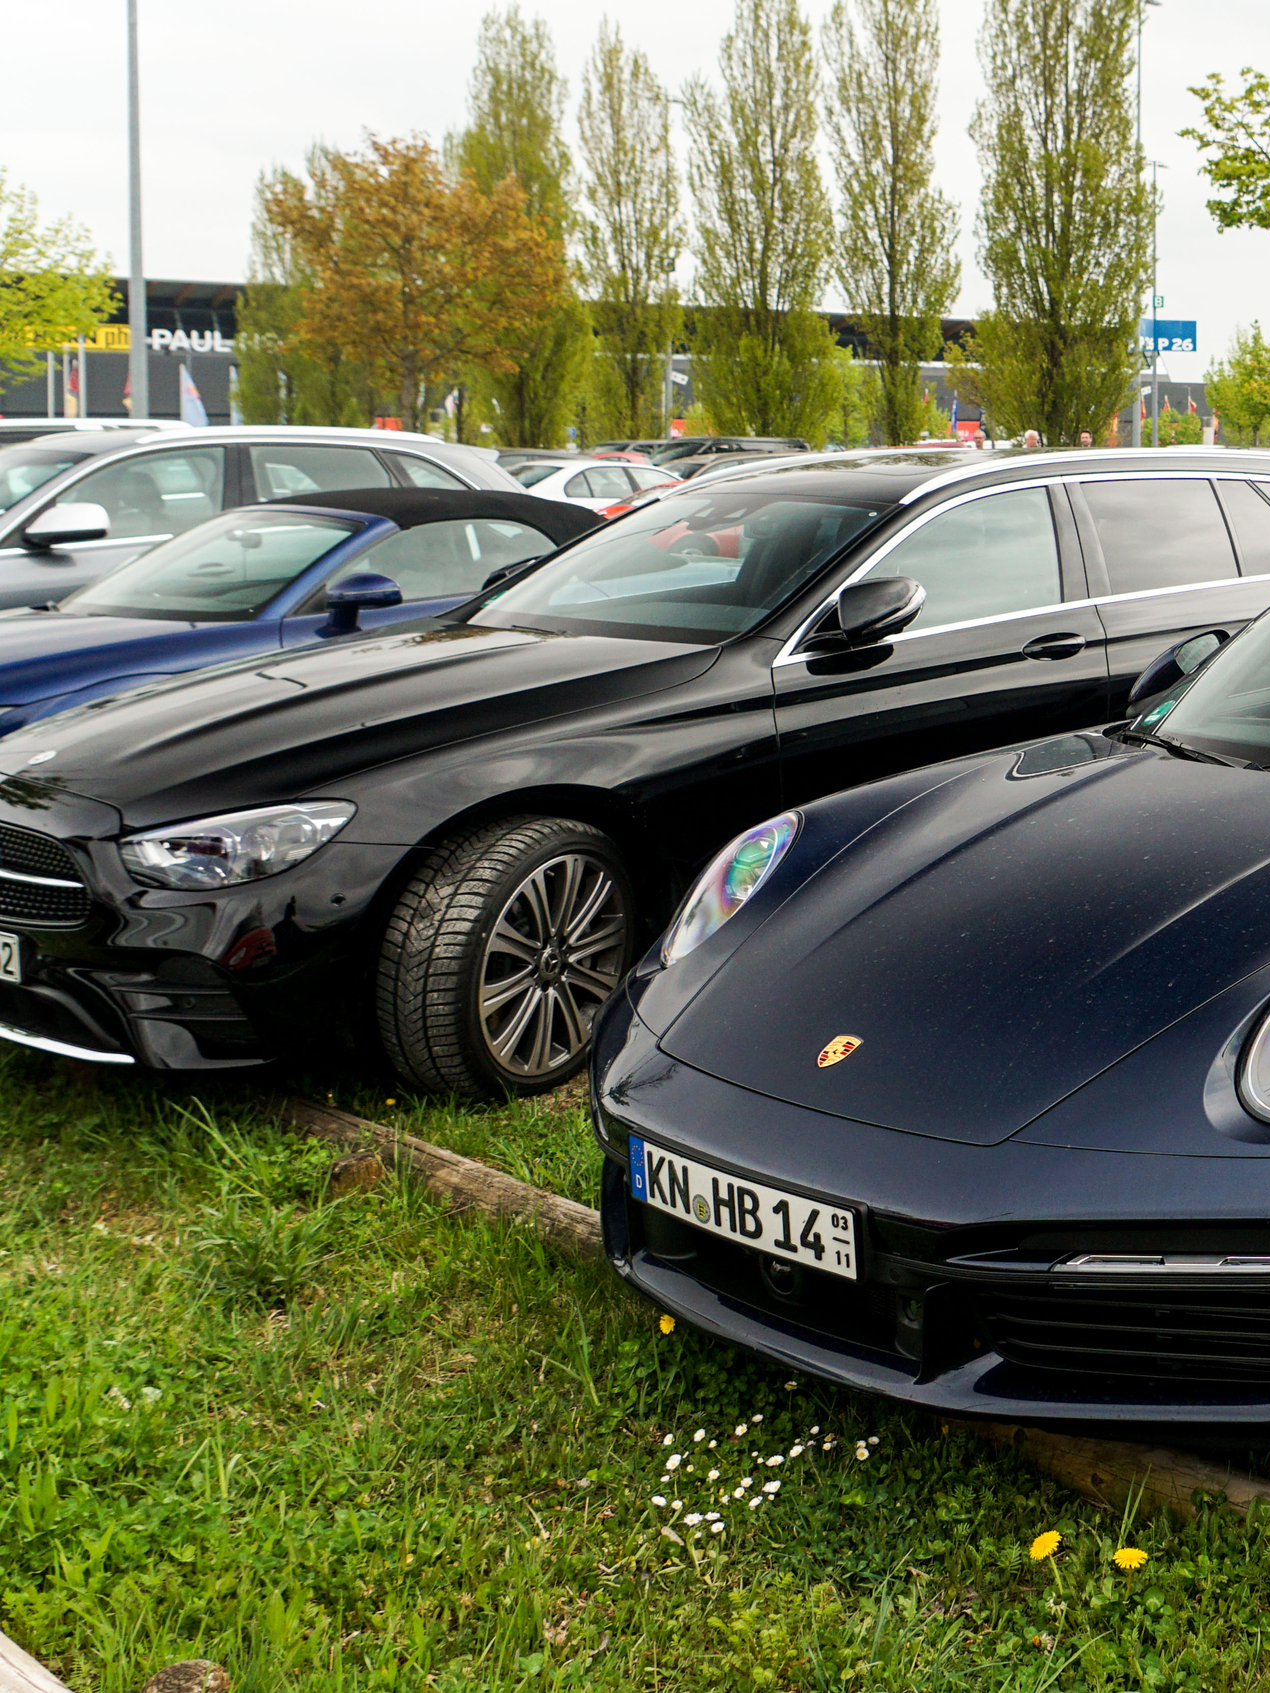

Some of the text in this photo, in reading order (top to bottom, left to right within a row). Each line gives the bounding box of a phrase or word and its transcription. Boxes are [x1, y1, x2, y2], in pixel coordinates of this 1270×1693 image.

[1154, 296, 1163, 308] B
[152, 328, 232, 352] PAUL
[1157, 337, 1194, 352] P 26
[2, 942, 15, 975] 2
[635, 1174, 643, 1189] D
[647, 1150, 826, 1261] KN HB 14
[831, 1212, 849, 1231] 03
[835, 1250, 851, 1269] 11
